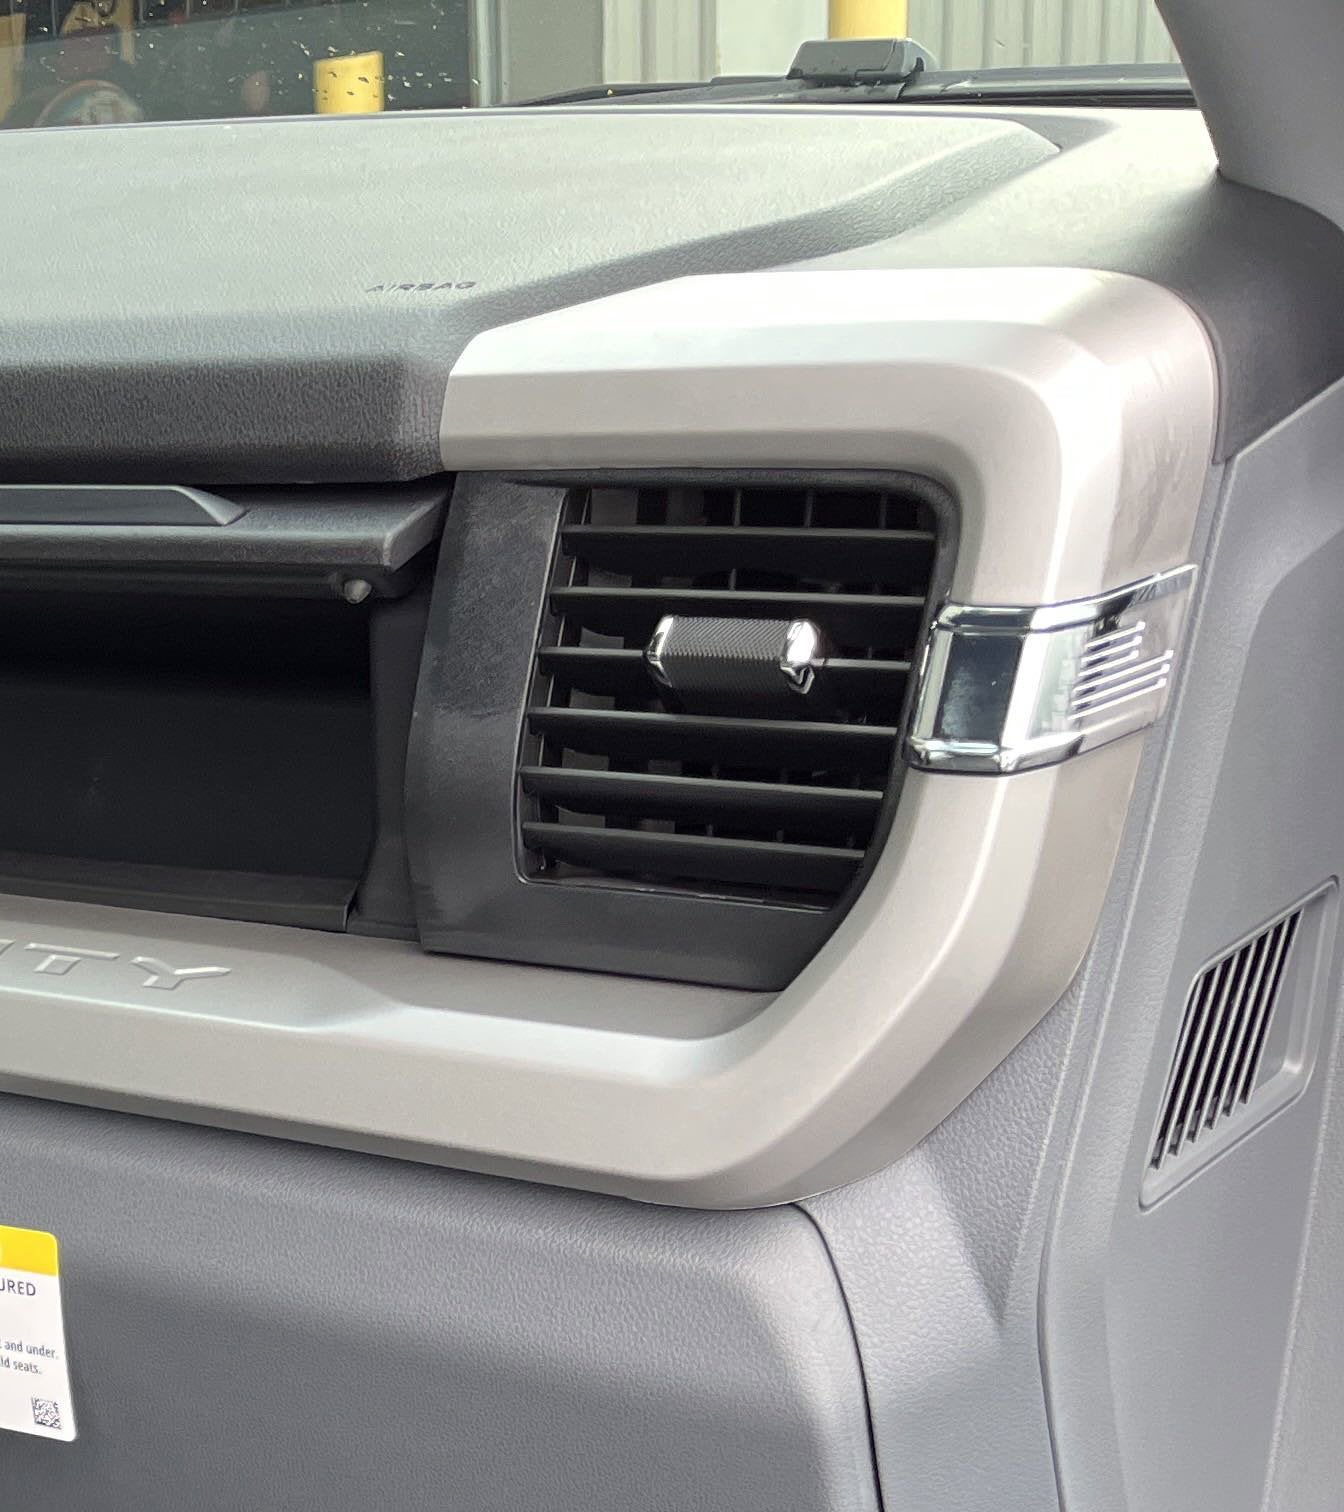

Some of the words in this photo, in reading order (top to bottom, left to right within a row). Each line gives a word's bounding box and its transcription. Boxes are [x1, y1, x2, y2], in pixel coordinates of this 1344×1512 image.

[4, 1340, 23, 1353] and
[25, 1344, 59, 1360] under.
[12, 1360, 43, 1375] seats.
